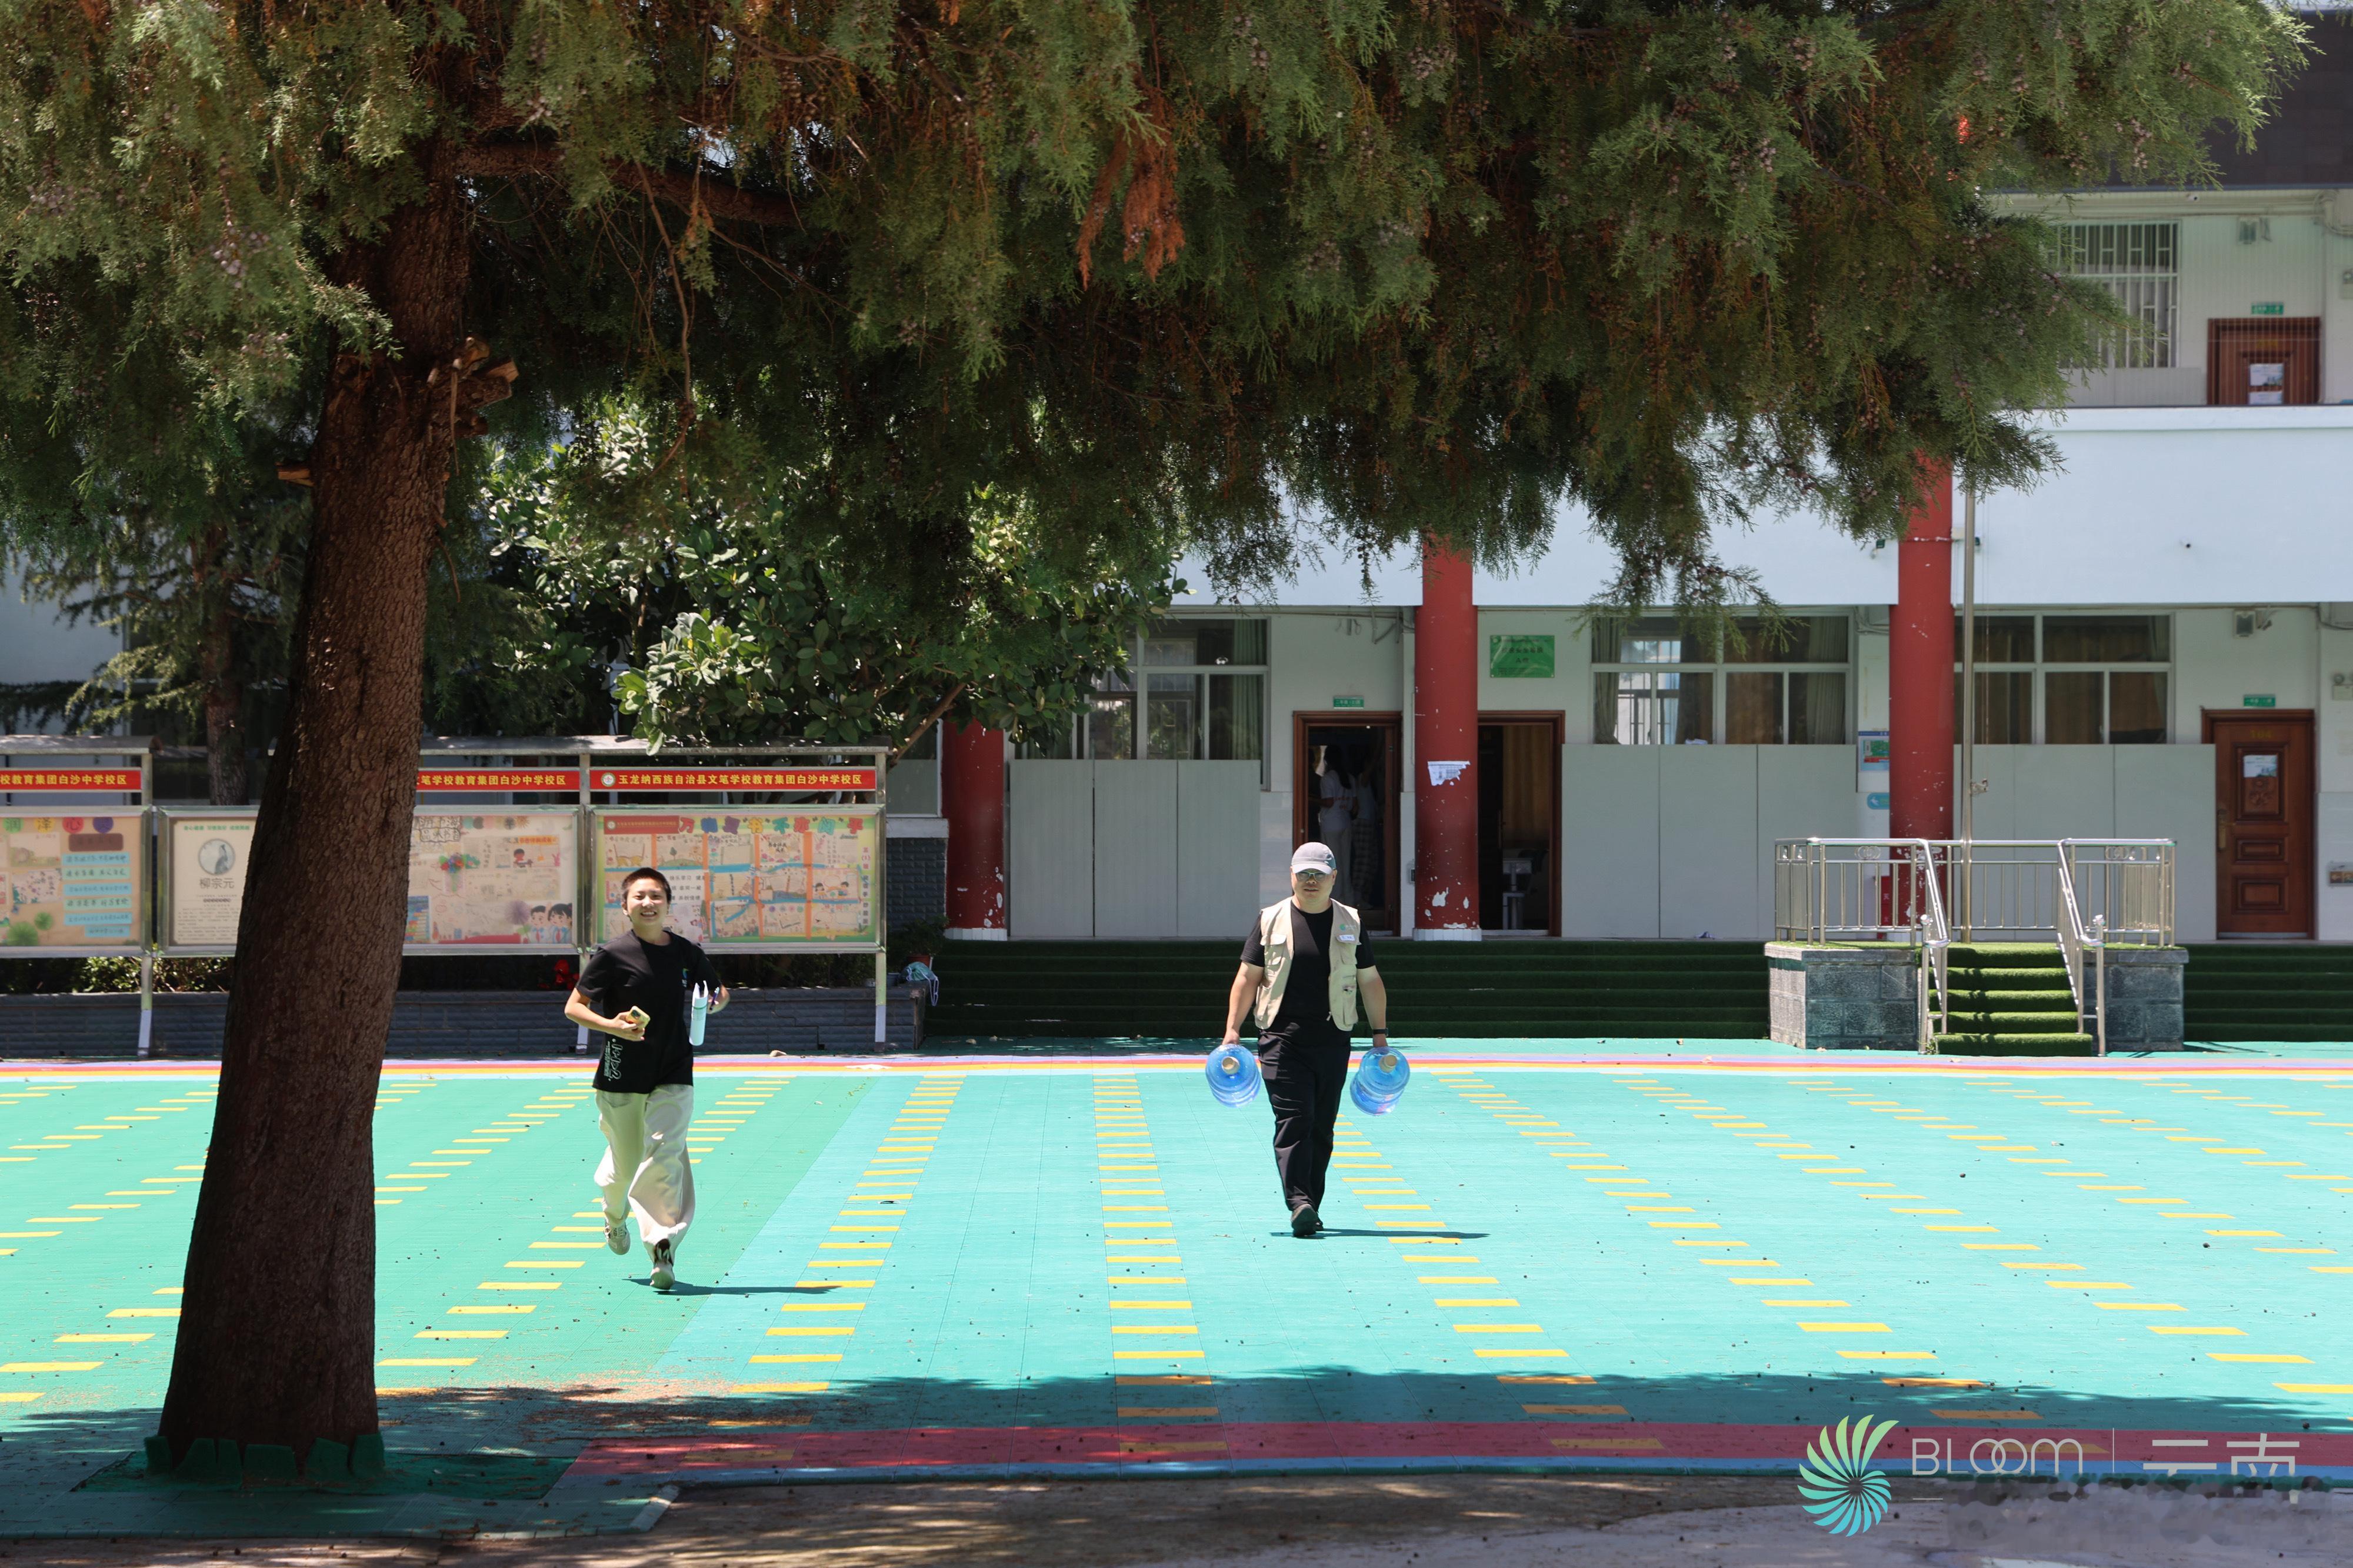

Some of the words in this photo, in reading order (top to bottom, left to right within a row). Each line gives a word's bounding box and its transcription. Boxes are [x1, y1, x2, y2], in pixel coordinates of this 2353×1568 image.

[0, 775, 127, 785] 校教育集团白沙中学校区
[618, 775, 862, 785] 玉龙纳西族自治县文笔学校教育集团白沙中学校区
[200, 878, 235, 889] 柳宗元
